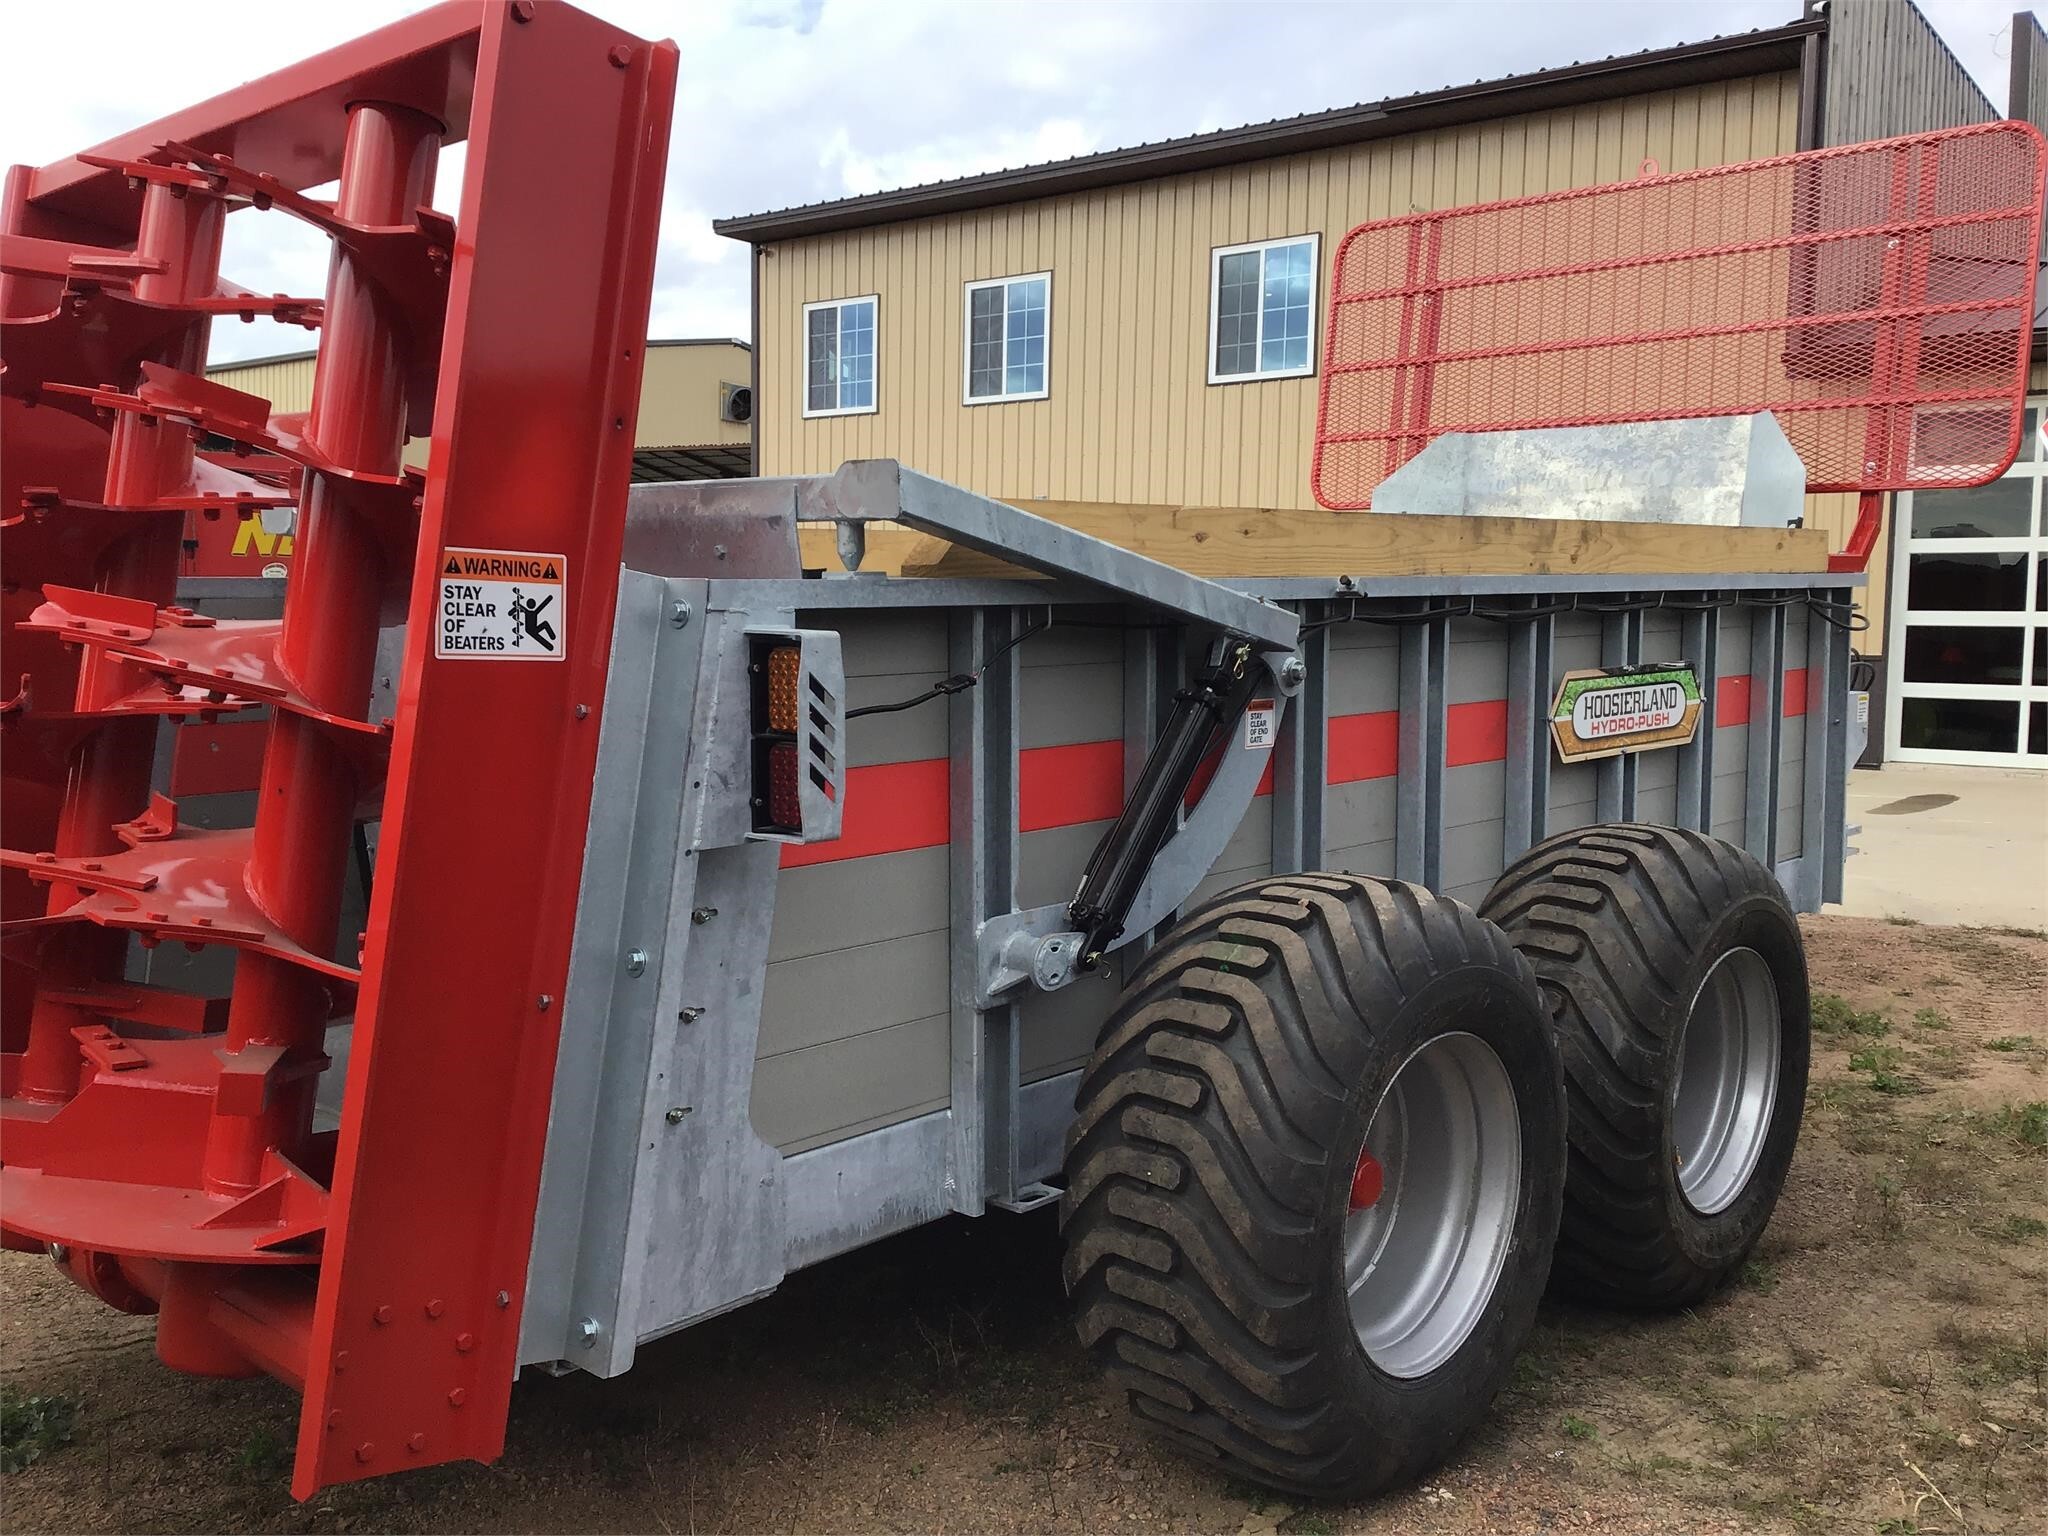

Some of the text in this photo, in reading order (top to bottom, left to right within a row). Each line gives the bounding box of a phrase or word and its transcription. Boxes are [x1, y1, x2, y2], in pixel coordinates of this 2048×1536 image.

[464, 557, 541, 579] WARNING
[444, 585, 482, 600] STAY
[444, 602, 496, 617] CLEAR
[444, 619, 466, 633] OF
[444, 635, 505, 650] BEATERS
[1584, 686, 1678, 720] HOOSIERLAND
[1250, 712, 1263, 720] STAY
[1250, 720, 1267, 728] CLEAR
[1250, 727, 1269, 736] OF END
[1591, 712, 1670, 736] HYDRO-PUSH
[1250, 735, 1263, 743] GATE
